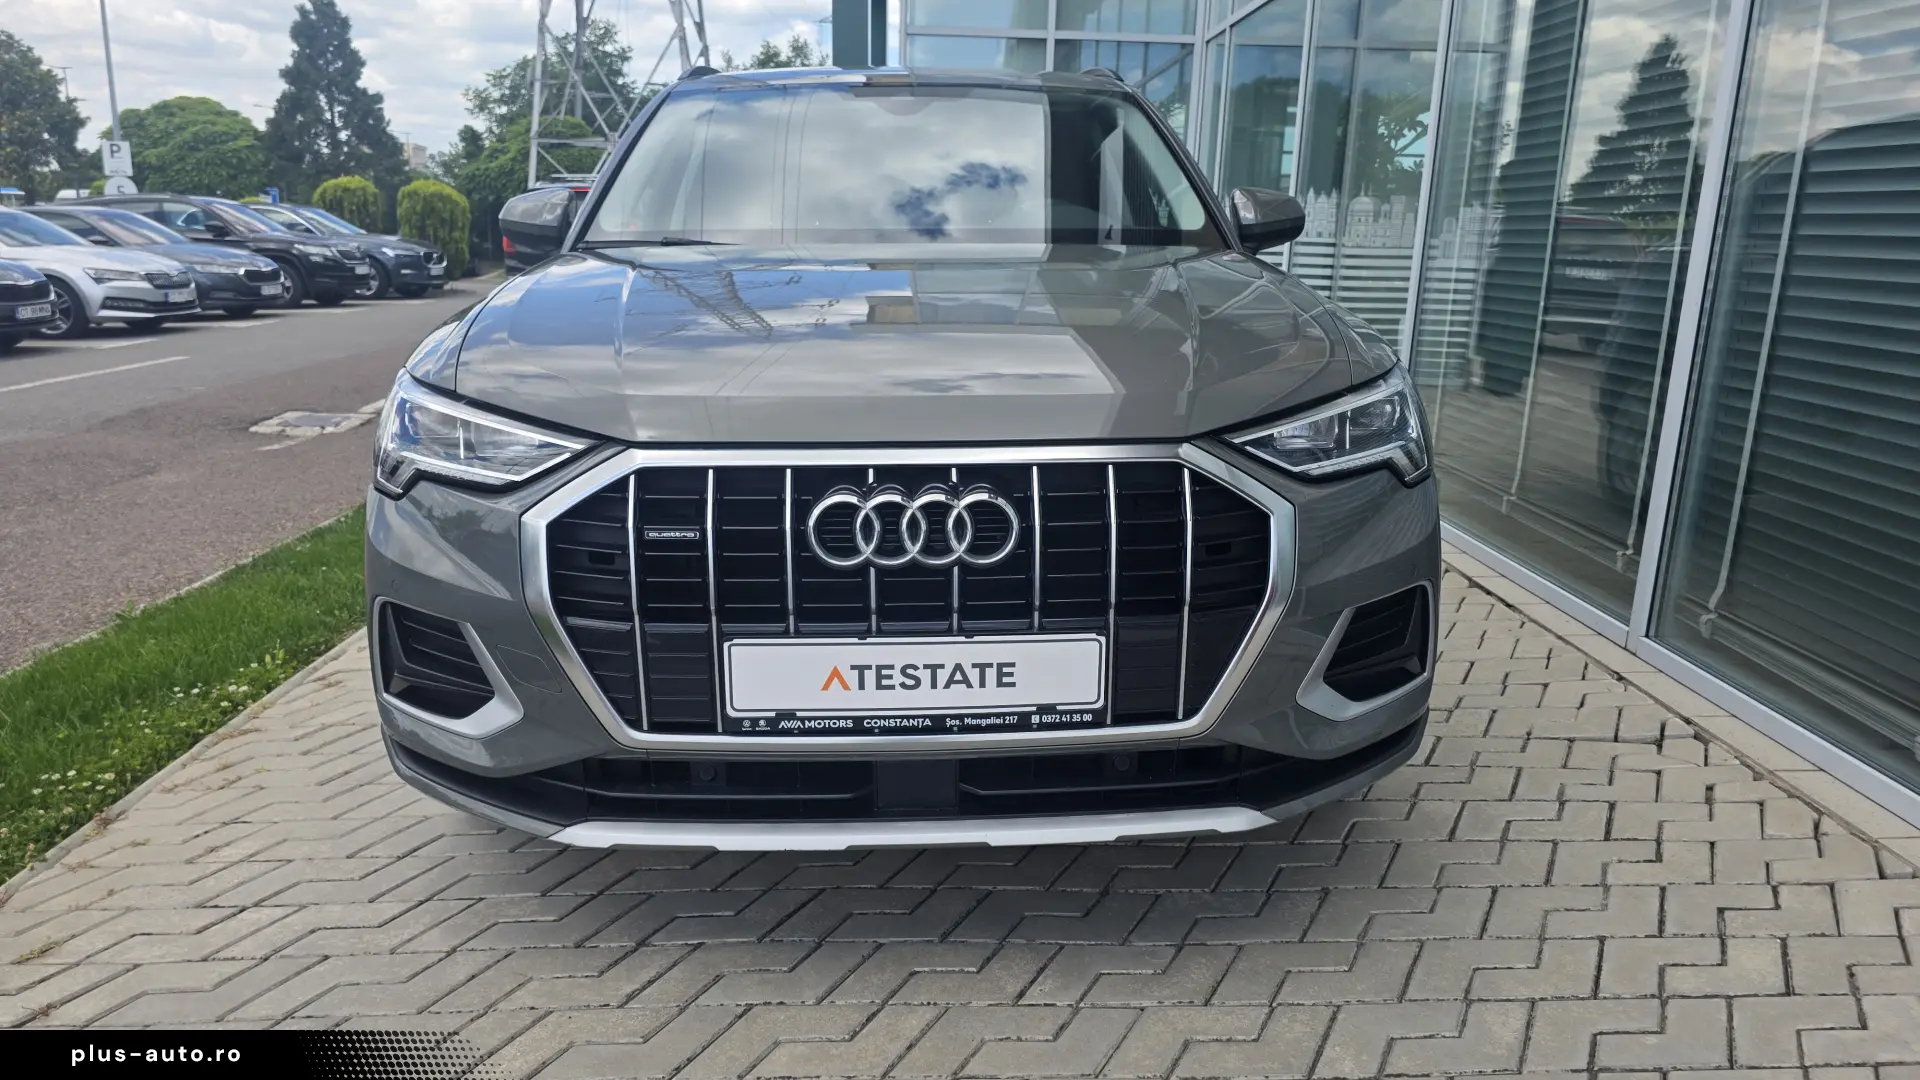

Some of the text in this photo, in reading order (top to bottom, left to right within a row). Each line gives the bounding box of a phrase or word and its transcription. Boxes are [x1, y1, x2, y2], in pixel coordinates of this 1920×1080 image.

[110, 143, 121, 159] P
[820, 662, 1016, 692] ATESTATE
[804, 719, 854, 729] MOTORS
[964, 716, 1004, 727] Mangaliei
[1004, 715, 1018, 724] 217
[1041, 714, 1060, 723] 0372
[1061, 713, 1070, 722] 41
[1071, 713, 1081, 722] 35
[1082, 713, 1093, 722] 00
